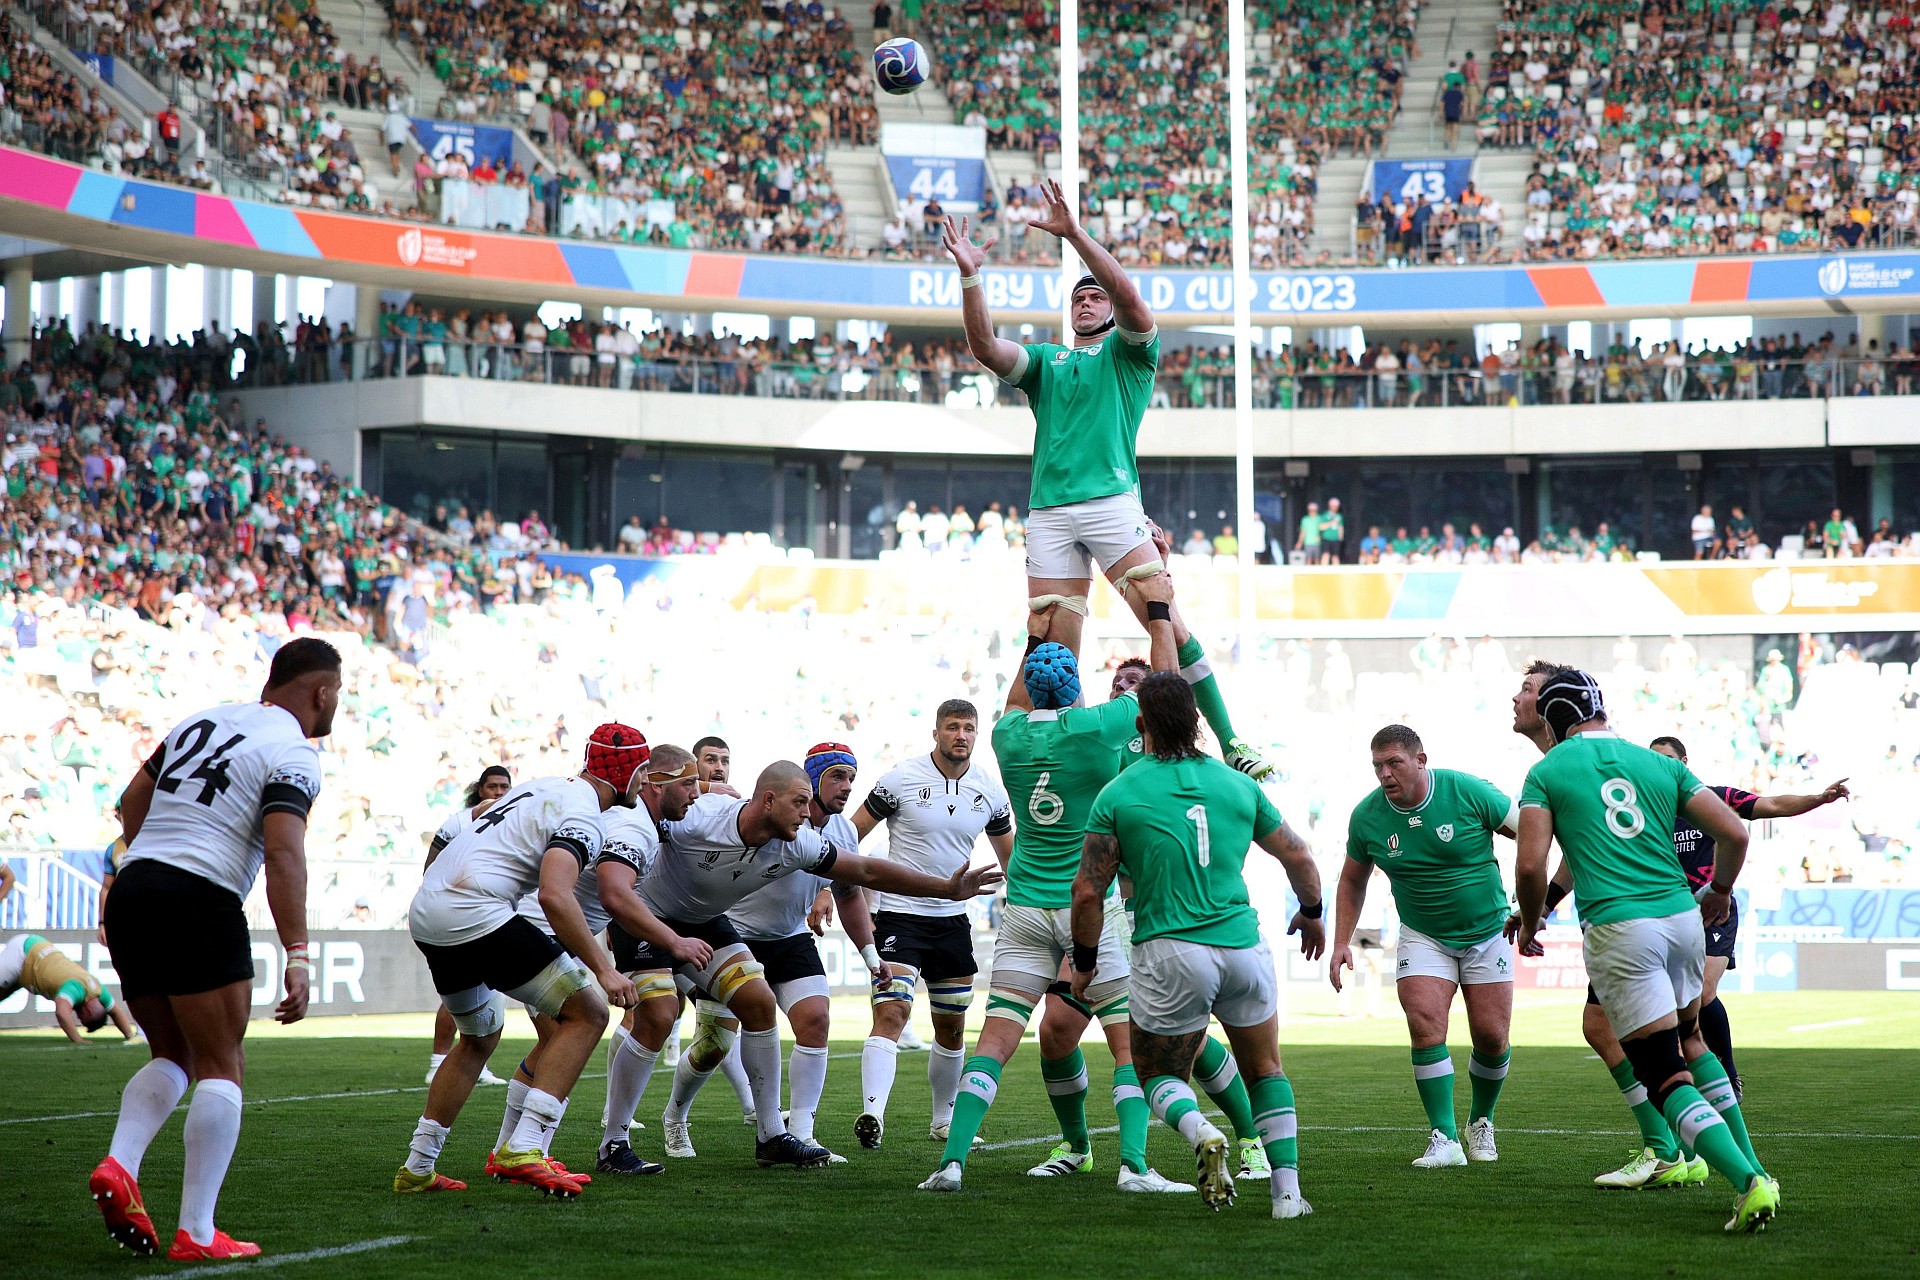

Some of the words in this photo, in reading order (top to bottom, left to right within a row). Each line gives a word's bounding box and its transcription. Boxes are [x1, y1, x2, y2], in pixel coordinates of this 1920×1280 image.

[431, 134, 475, 167] 45
[909, 168, 959, 200] 44
[1401, 171, 1446, 202] 43
[909, 270, 1034, 309] RUBY
[1267, 276, 1356, 311] 2023
[156, 719, 247, 807] 24
[475, 791, 534, 834] 4
[1029, 771, 1064, 826] 6
[1601, 777, 1645, 839] 8
[1186, 804, 1210, 868] 1
[1673, 841, 1696, 854] ETTER
